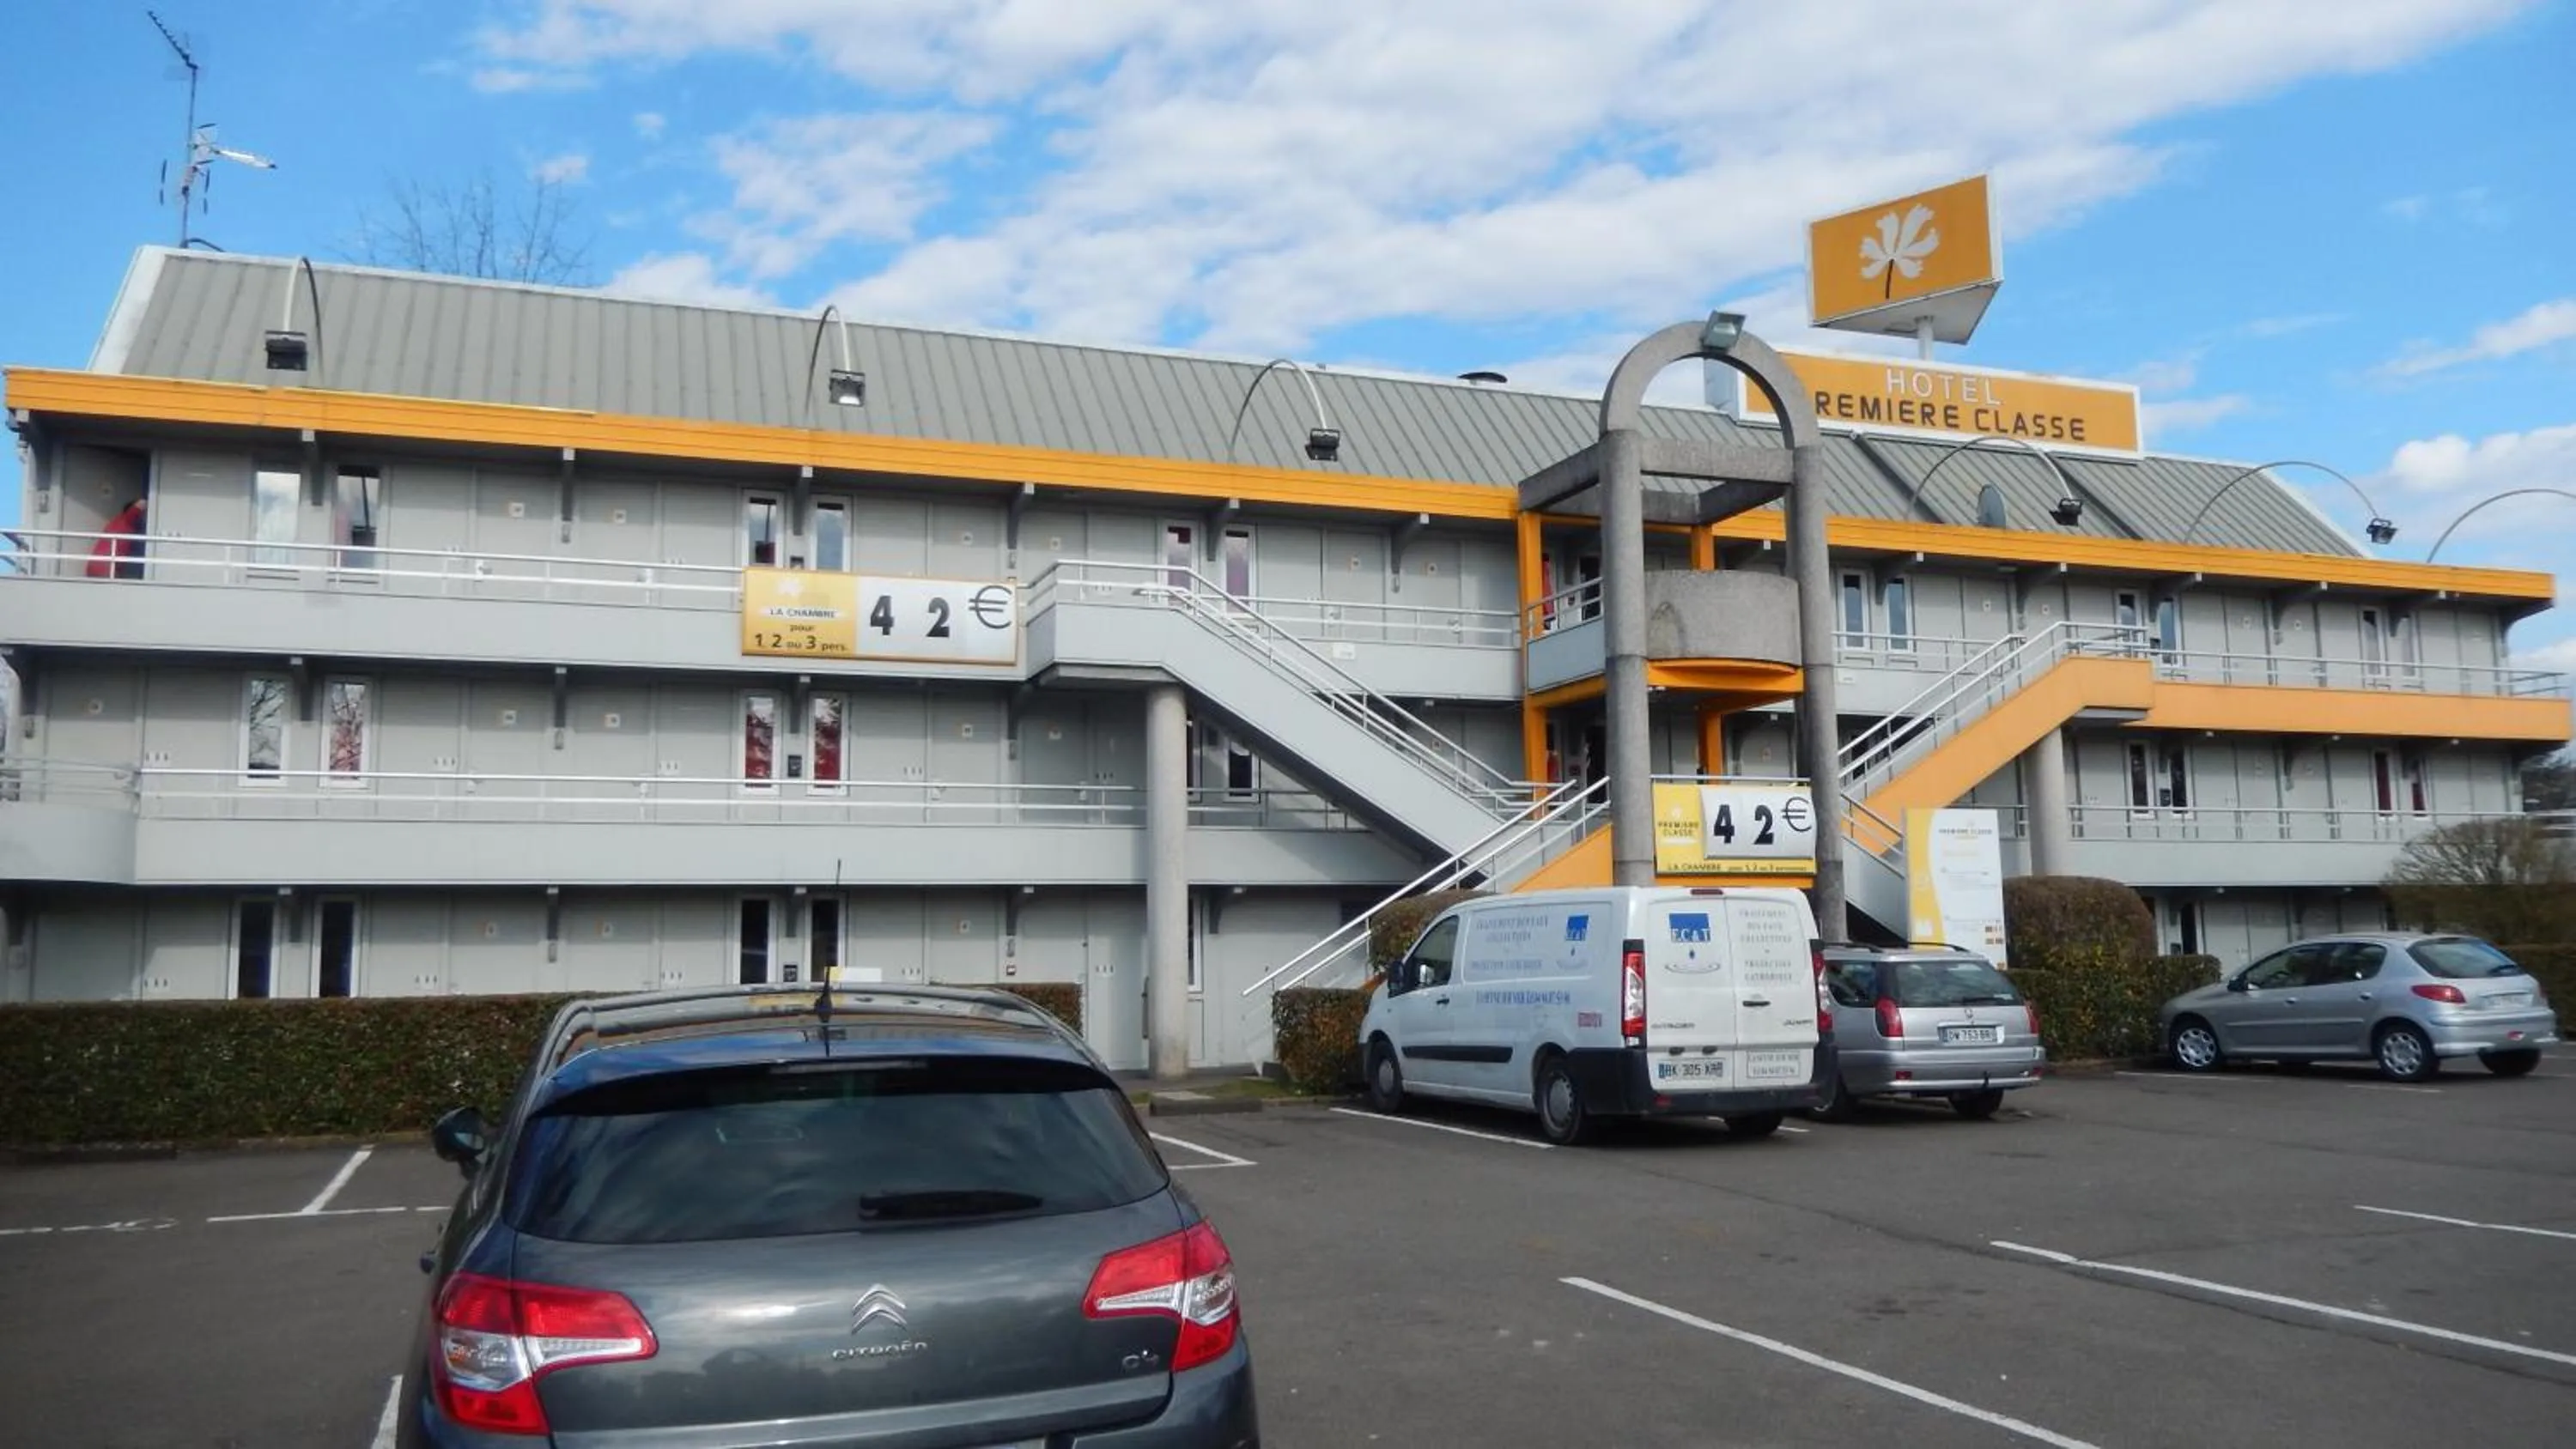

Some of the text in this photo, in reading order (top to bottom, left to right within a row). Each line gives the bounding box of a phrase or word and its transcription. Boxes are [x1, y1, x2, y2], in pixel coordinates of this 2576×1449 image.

[1886, 367, 2002, 406] HOTEL
[1815, 390, 2087, 442] REMIERE CLASSE
[769, 607, 835, 619] LA CHAMBRE
[789, 623, 815, 633] pour
